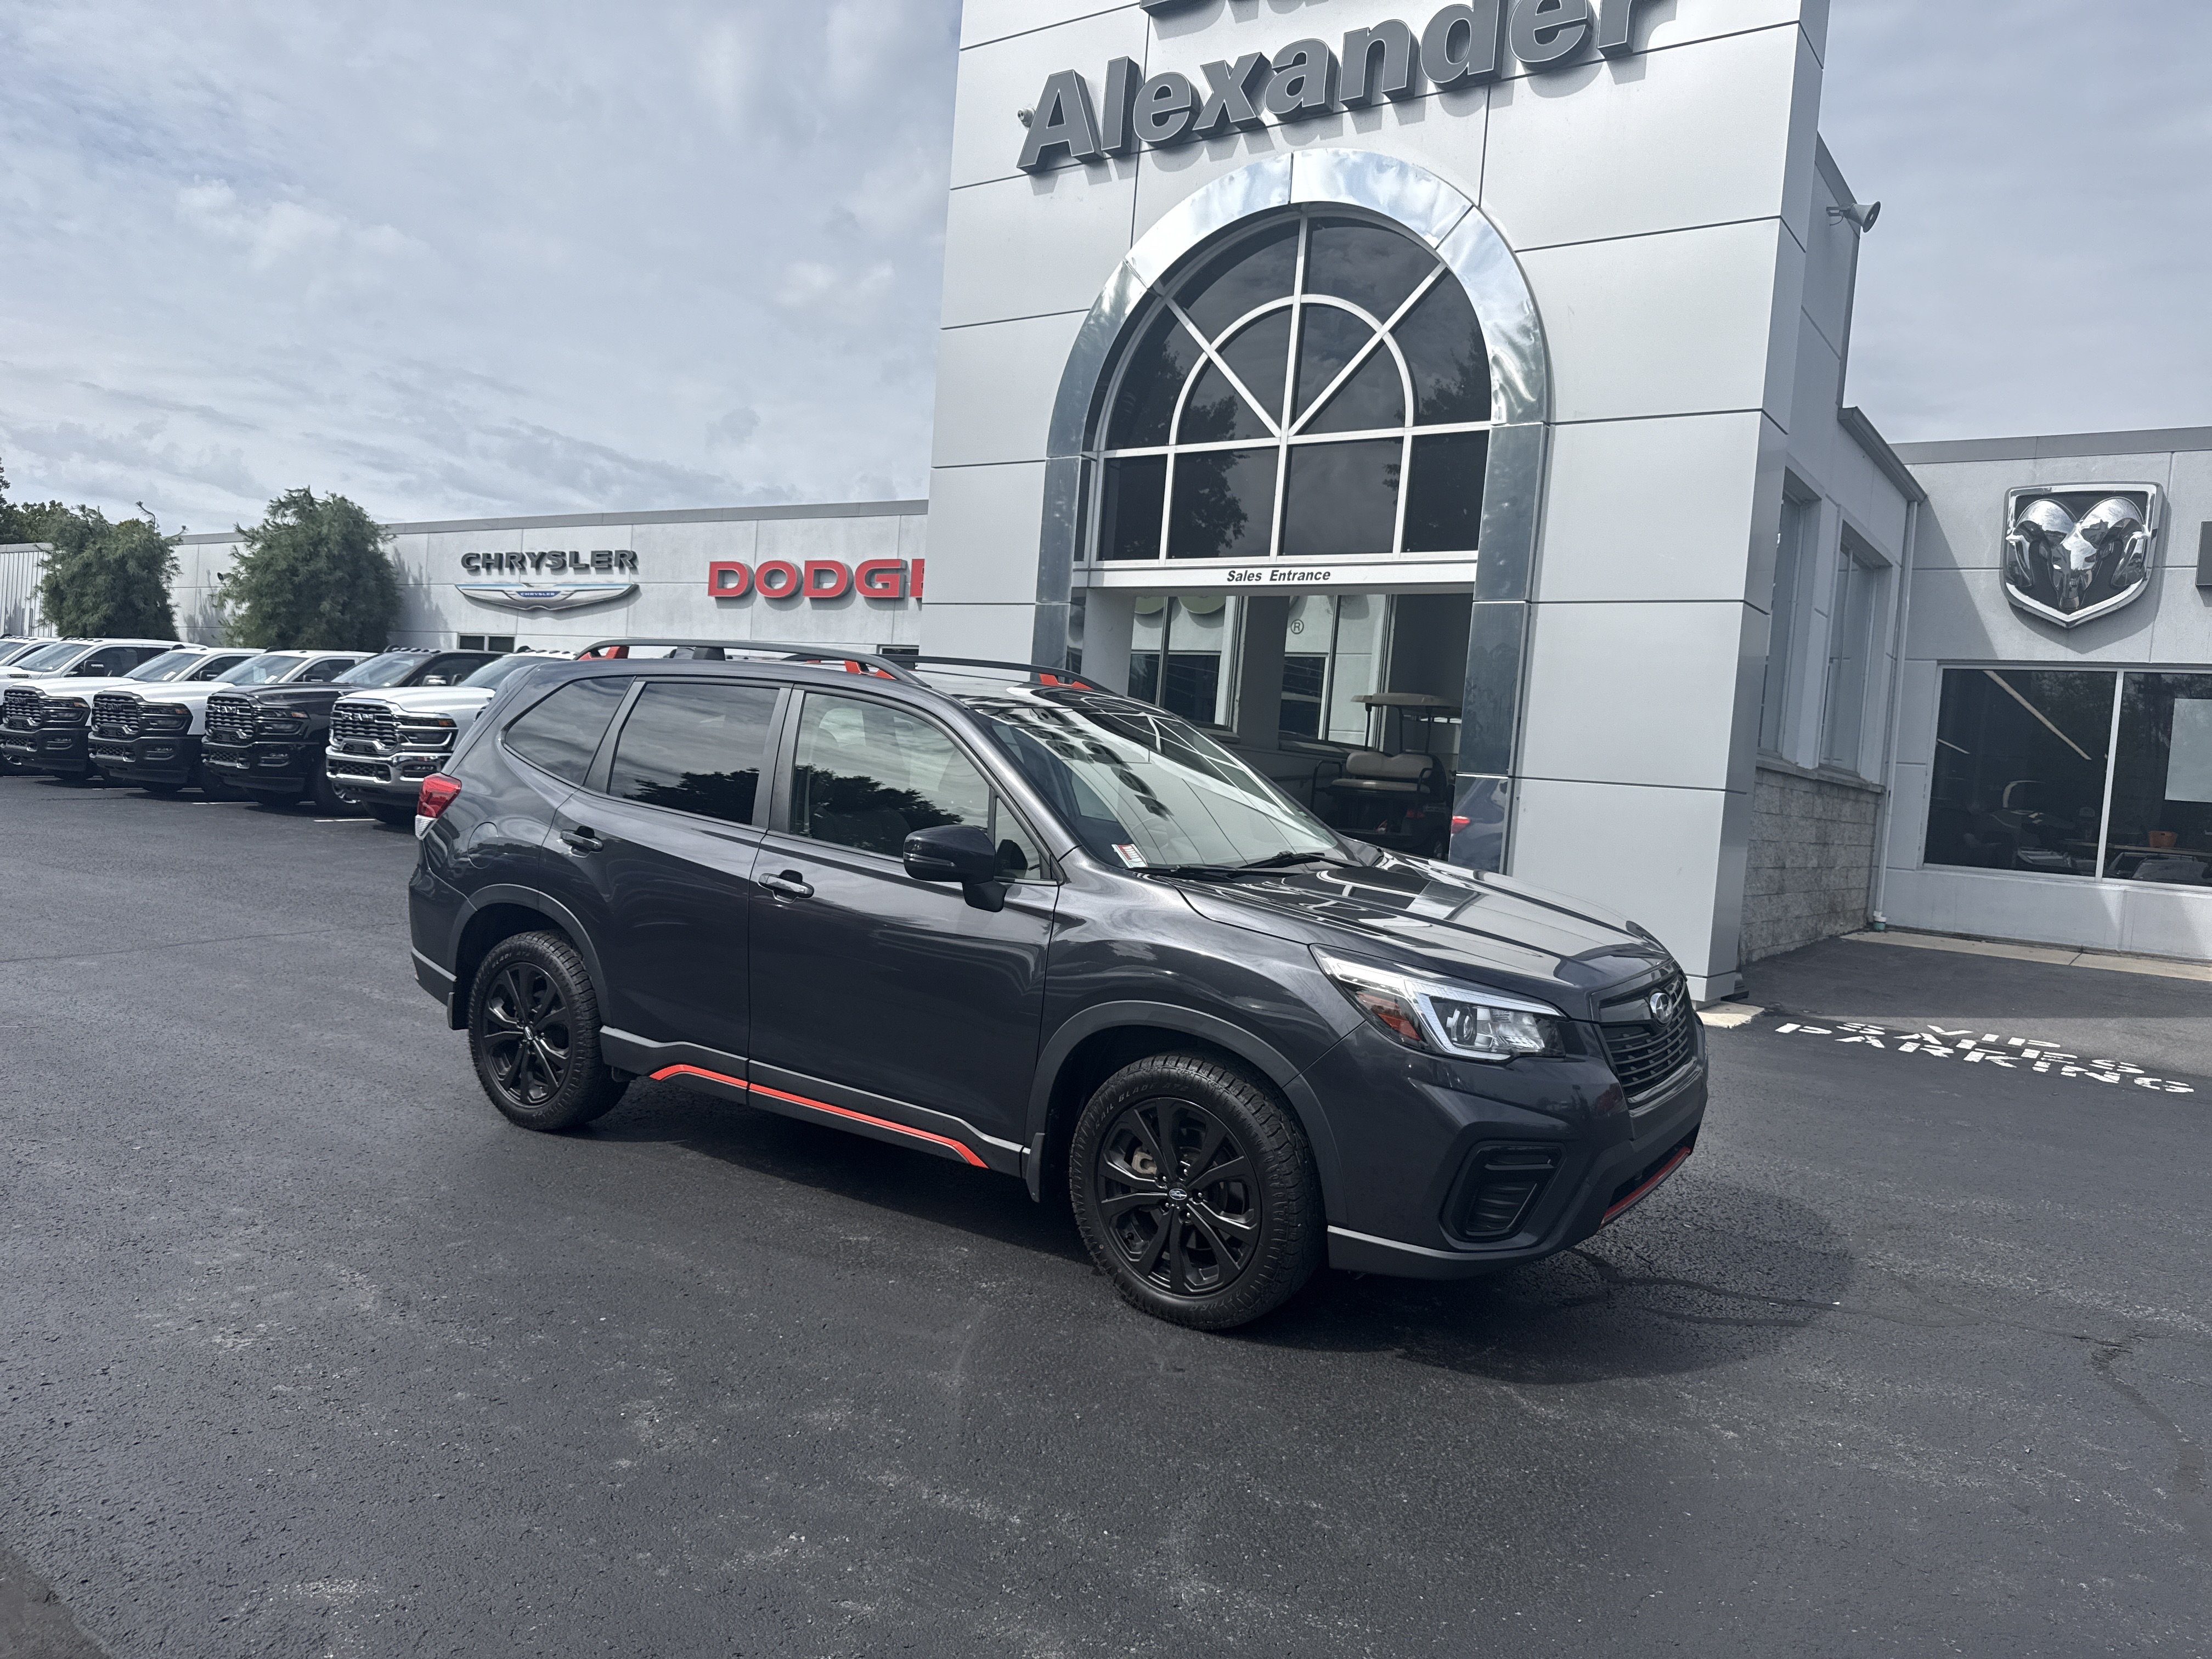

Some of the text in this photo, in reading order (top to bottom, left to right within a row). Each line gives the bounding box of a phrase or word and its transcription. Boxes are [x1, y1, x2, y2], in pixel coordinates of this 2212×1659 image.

[1017, 0, 1634, 173] Alexander
[461, 550, 637, 571] CHRYSLER
[1227, 569, 1331, 582] Sales Entrance
[341, 712, 374, 721] RAM
[1836, 1022, 2145, 1074] SALES
[1927, 1024, 2061, 1048] VIP
[1775, 1023, 2194, 1093] PARKING
